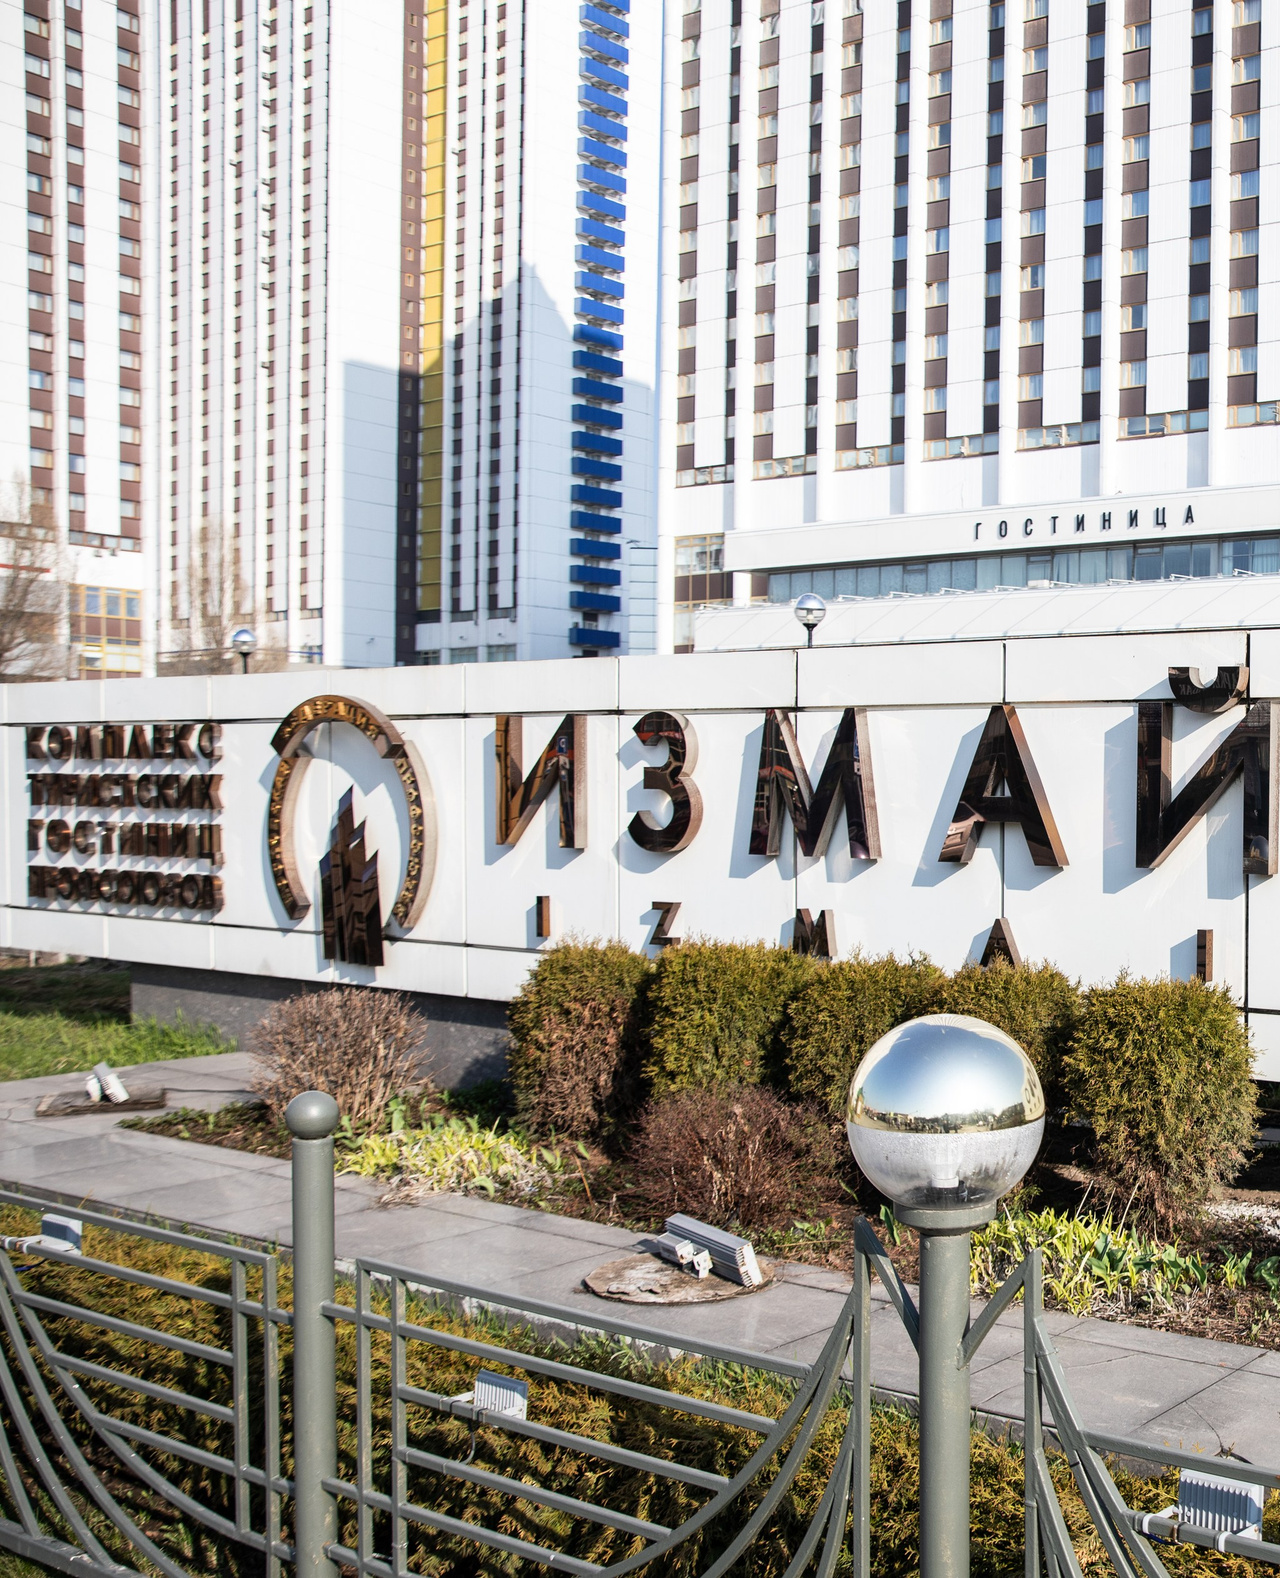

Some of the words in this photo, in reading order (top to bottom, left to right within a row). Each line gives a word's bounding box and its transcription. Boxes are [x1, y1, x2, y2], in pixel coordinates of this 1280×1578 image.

[974, 504, 1195, 541] ГОСТИНИЦА
[25, 722, 224, 760] КОМПЛЕКС
[27, 773, 224, 810] ТУРИСТСКИХ
[28, 818, 225, 867] ГОСТИНИЦ
[29, 865, 225, 911] ПРОФСОЮЗОВ
